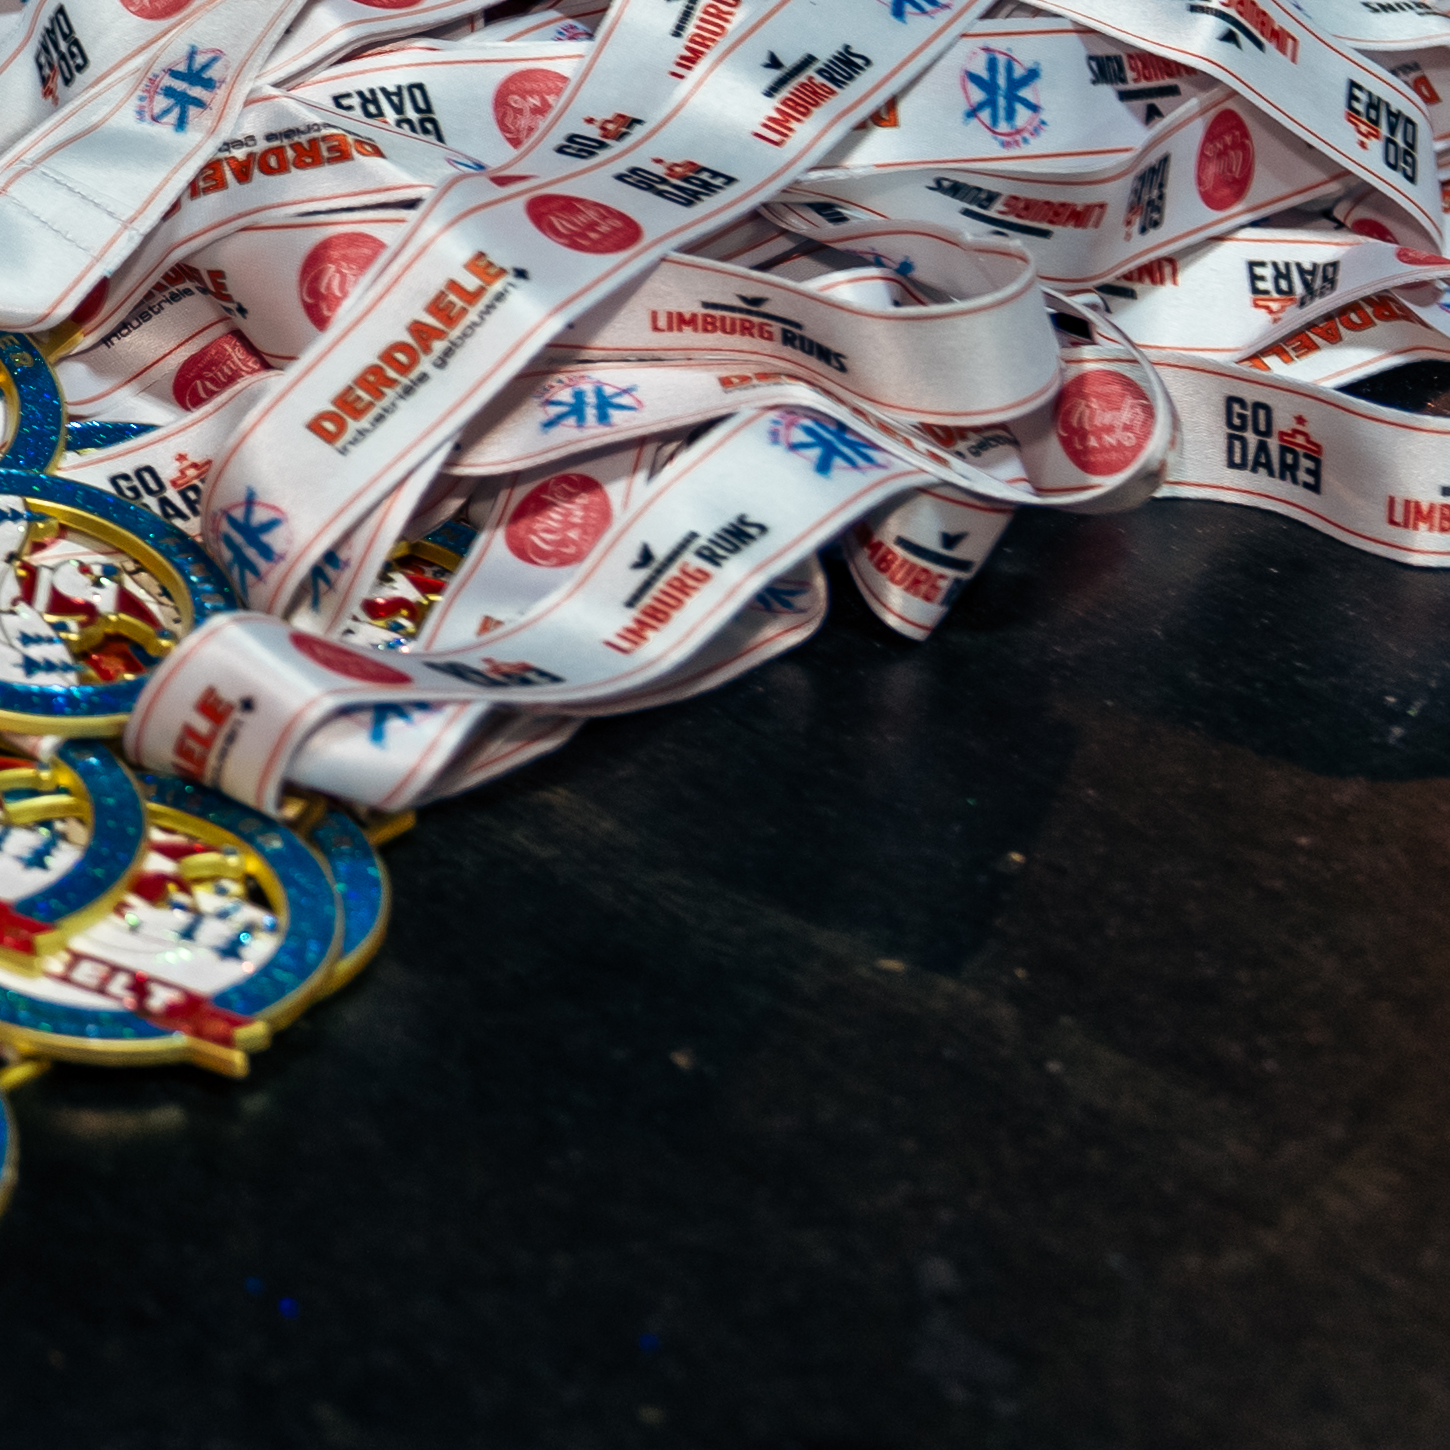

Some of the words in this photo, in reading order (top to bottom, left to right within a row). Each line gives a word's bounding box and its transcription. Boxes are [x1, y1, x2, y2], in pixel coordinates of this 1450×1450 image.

[57, 34, 90, 88] GO
[751, 75, 838, 148] LIMBURG
[816, 43, 874, 91] RUNS
[1347, 78, 1418, 154] DARE
[554, 132, 602, 161] GO
[1384, 136, 1418, 185] GO
[612, 166, 667, 193] GO
[652, 166, 739, 209] DARE
[996, 193, 1108, 230] LIMBURG
[304, 251, 509, 445] DERDAELE
[650, 309, 775, 342] LIMBURG
[780, 326, 849, 374] RUNS
[1237, 293, 1425, 373] RDAEL
[1225, 395, 1274, 438] GO
[108, 463, 168, 504] GO
[1227, 432, 1323, 495] DARE
[602, 561, 714, 656] LIMBURG
[706, 512, 771, 568] RUNS
